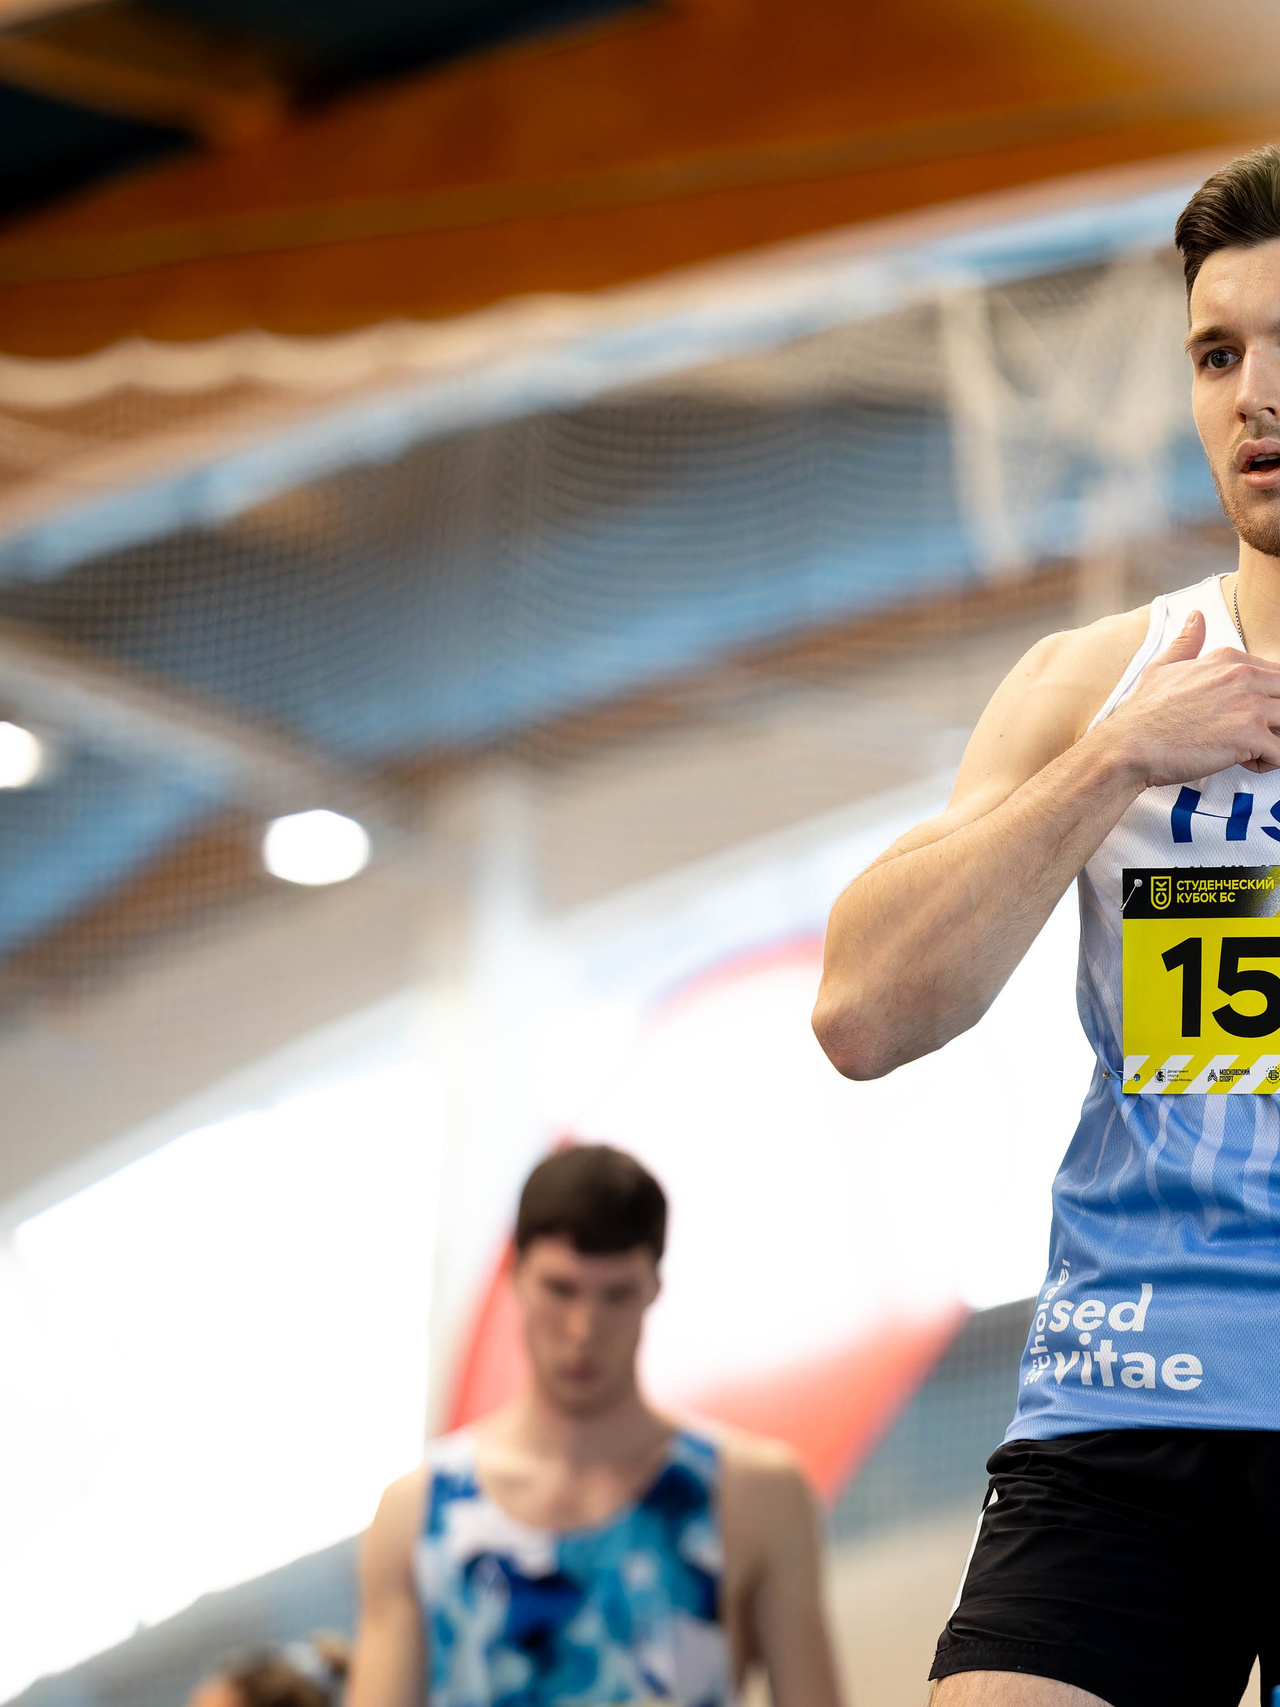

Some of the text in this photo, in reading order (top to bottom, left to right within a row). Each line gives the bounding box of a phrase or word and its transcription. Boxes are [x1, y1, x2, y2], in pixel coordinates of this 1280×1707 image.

[1176, 877, 1275, 892] СТУДЕНЧЕСКИЙ
[1176, 891, 1236, 903] КУБОК БС
[1048, 1283, 1153, 1333] sed
[1053, 1332, 1203, 1391] vitae
